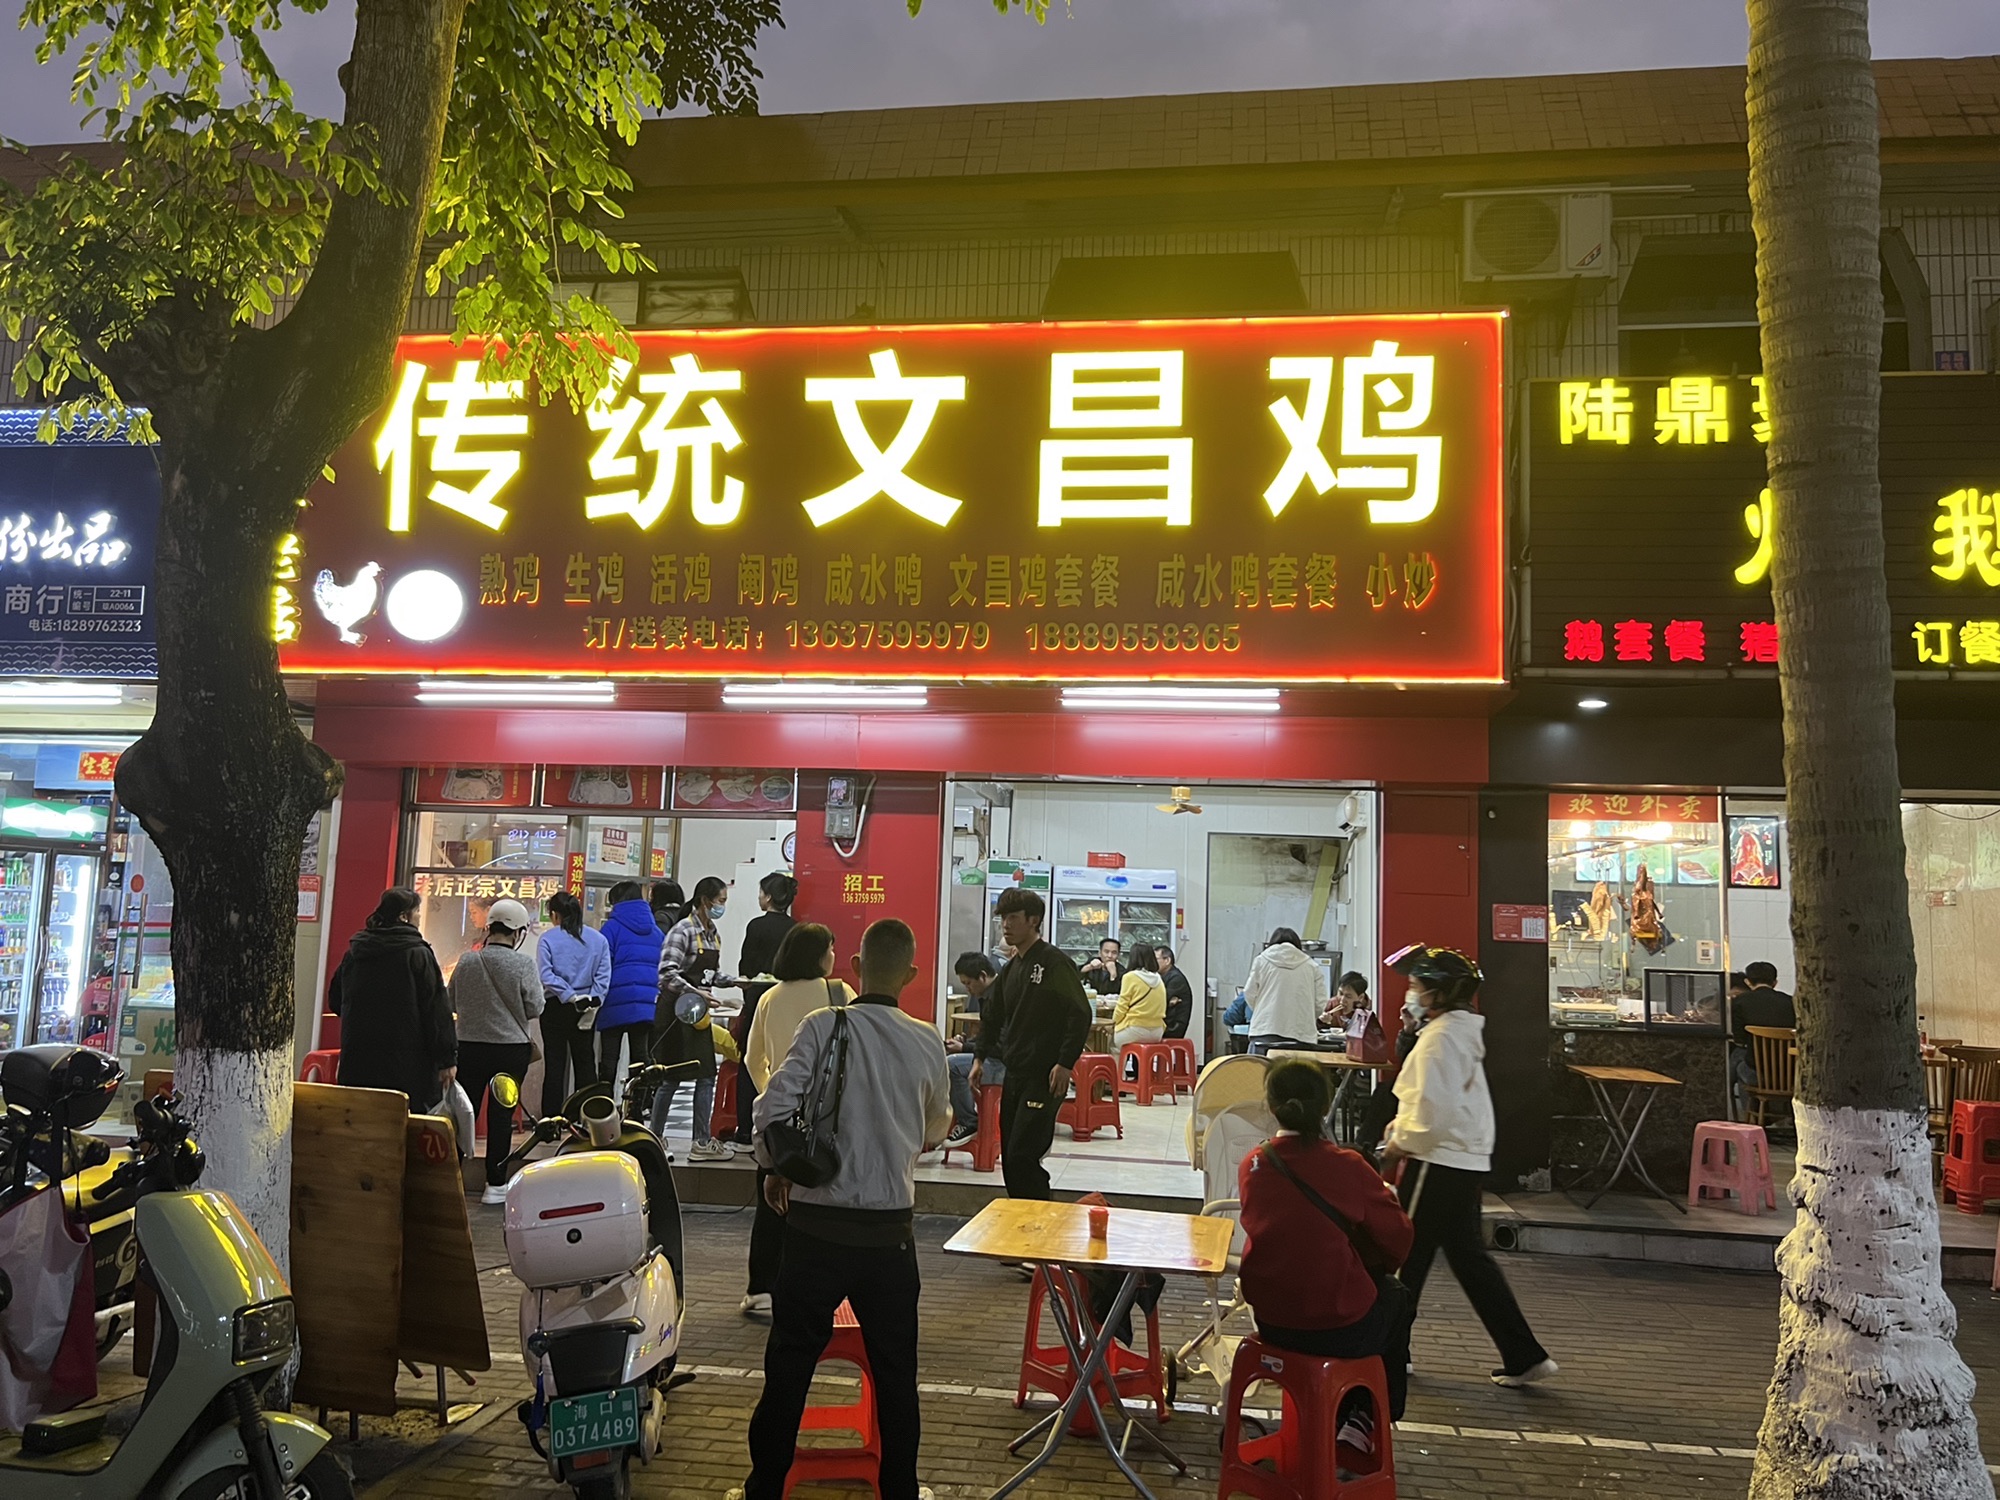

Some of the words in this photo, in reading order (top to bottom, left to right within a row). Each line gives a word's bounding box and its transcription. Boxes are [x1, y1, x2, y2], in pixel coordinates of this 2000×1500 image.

[374, 338, 1444, 533] 传统文昌鸡
[479, 552, 541, 605] 熟鸡
[564, 552, 625, 604] 生鸡
[649, 553, 711, 605] 活鸡
[737, 552, 799, 606] 阉鸡
[824, 553, 923, 606] 咸水鸭
[948, 553, 1120, 609] 文昌鸡套餐
[1156, 553, 1338, 609] 咸水鸭套餐
[1366, 552, 1437, 609] 小炒
[4, 584, 64, 615] 商行
[785, 618, 990, 650] 13637595979
[1025, 622, 1241, 652] 18889558365
[1564, 619, 1705, 663] 鹅套餐
[1568, 794, 1702, 821] 欢迎外卖
[844, 873, 884, 892] 招工
[555, 1417, 634, 1448] 0374489
